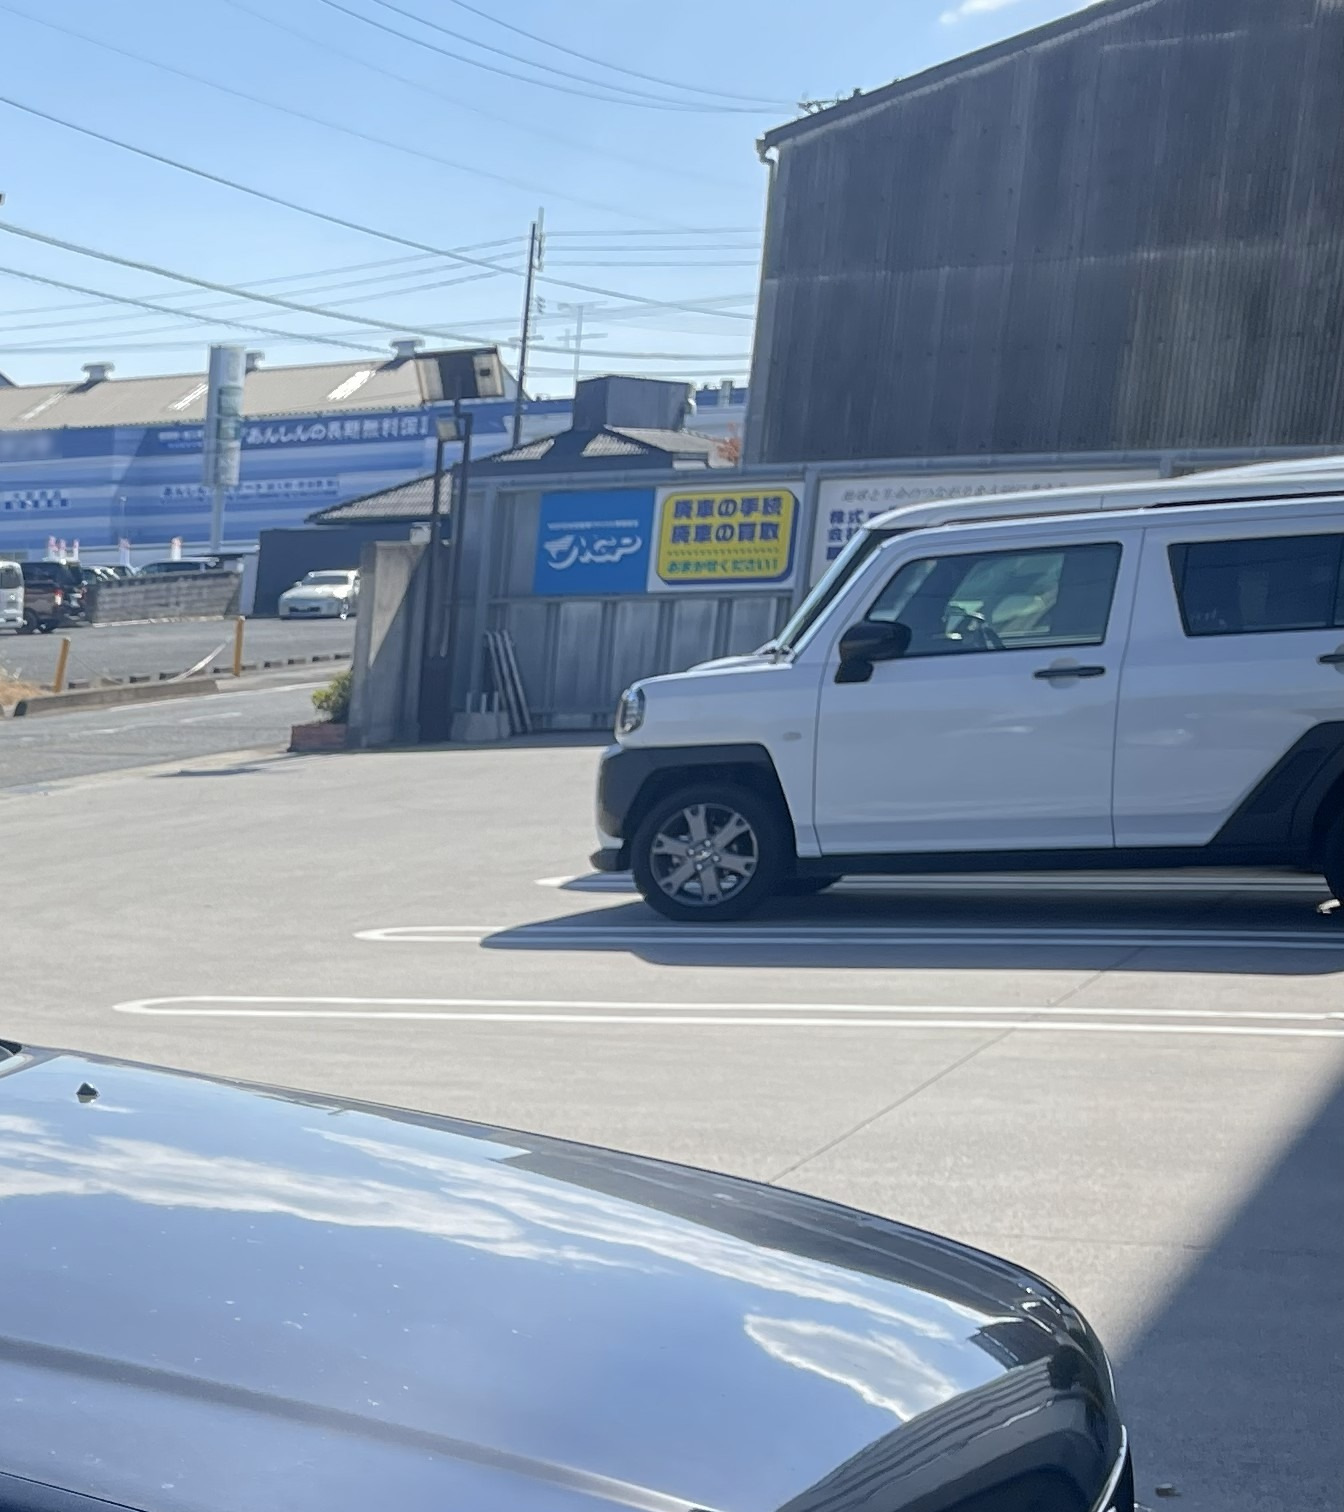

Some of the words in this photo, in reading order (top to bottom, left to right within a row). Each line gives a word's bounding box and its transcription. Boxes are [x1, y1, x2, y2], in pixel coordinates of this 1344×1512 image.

[671, 521, 780, 544] 廃車の買取
